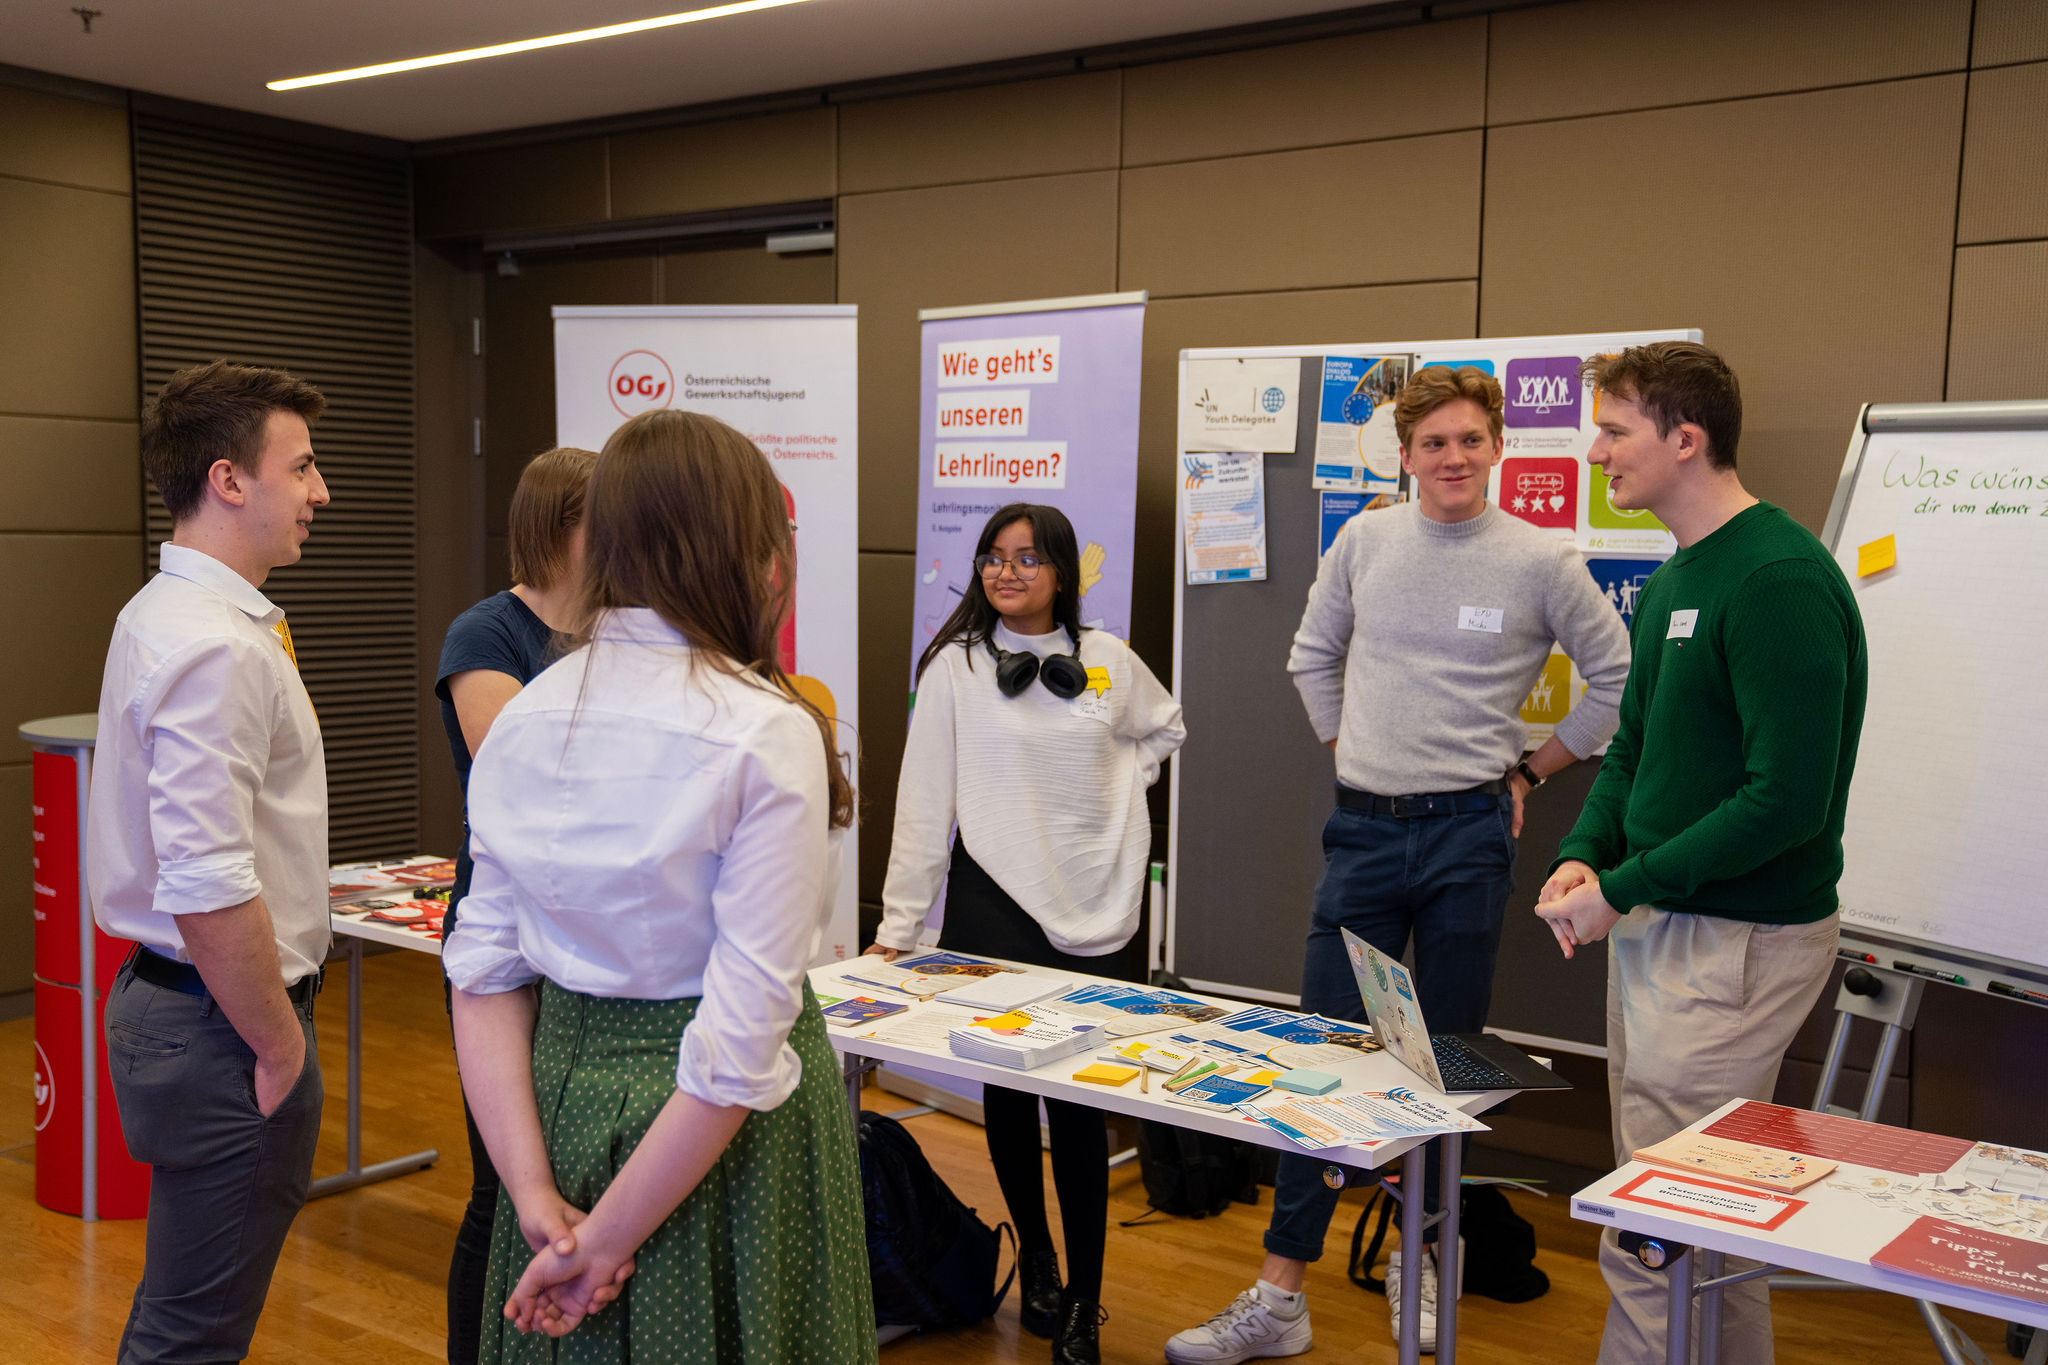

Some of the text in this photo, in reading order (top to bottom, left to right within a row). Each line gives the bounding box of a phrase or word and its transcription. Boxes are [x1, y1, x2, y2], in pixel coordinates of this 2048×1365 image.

[943, 354, 979, 377] Wie
[684, 373, 772, 387] Österreichische
[684, 388, 806, 402] Gewerkschaftsjugend
[1205, 404, 1218, 413] UN
[940, 406, 1024, 427] unseren
[1204, 414, 1277, 426] Youth Delegates
[785, 433, 838, 448] politische
[1505, 437, 1520, 449] #2
[772, 447, 838, 461] Österreichs.
[938, 453, 1061, 484] Lehrlingen?
[1882, 450, 1959, 489] Was
[1913, 496, 1942, 514] dir
[1952, 503, 1976, 514] von
[1985, 501, 2031, 515] deiner
[1588, 538, 1604, 549] #6
[1031, 1004, 1059, 1016] Politik
[1012, 1012, 1059, 1028] Menschen
[1658, 1188, 1757, 1214] Blasmusikjugend
[1667, 1186, 1759, 1208] Österreichische
[1928, 1235, 1998, 1257] Tipps
